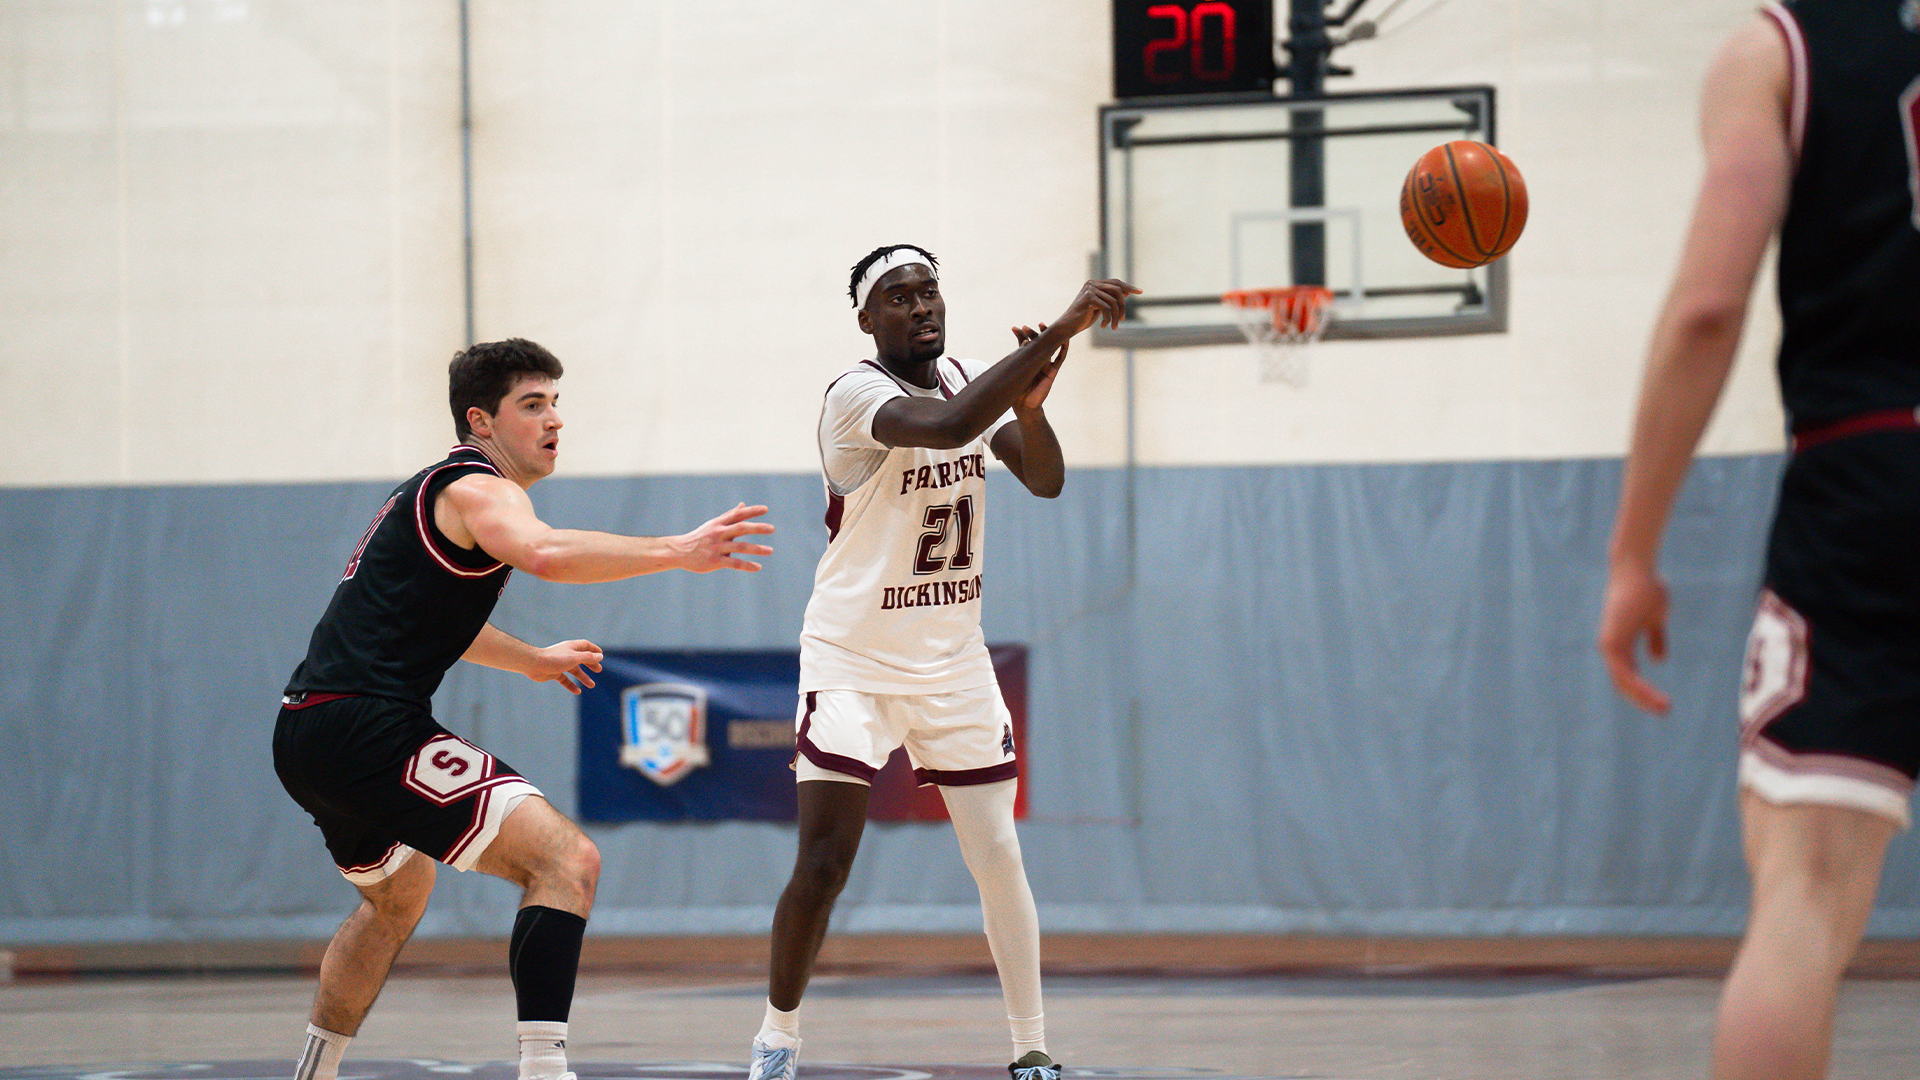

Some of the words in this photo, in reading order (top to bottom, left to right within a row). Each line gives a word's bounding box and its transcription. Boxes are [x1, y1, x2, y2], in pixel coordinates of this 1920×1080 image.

[1143, 2, 1237, 81] 20
[913, 495, 974, 575] 21
[881, 573, 982, 609] DICKINSON
[430, 750, 470, 776] S
